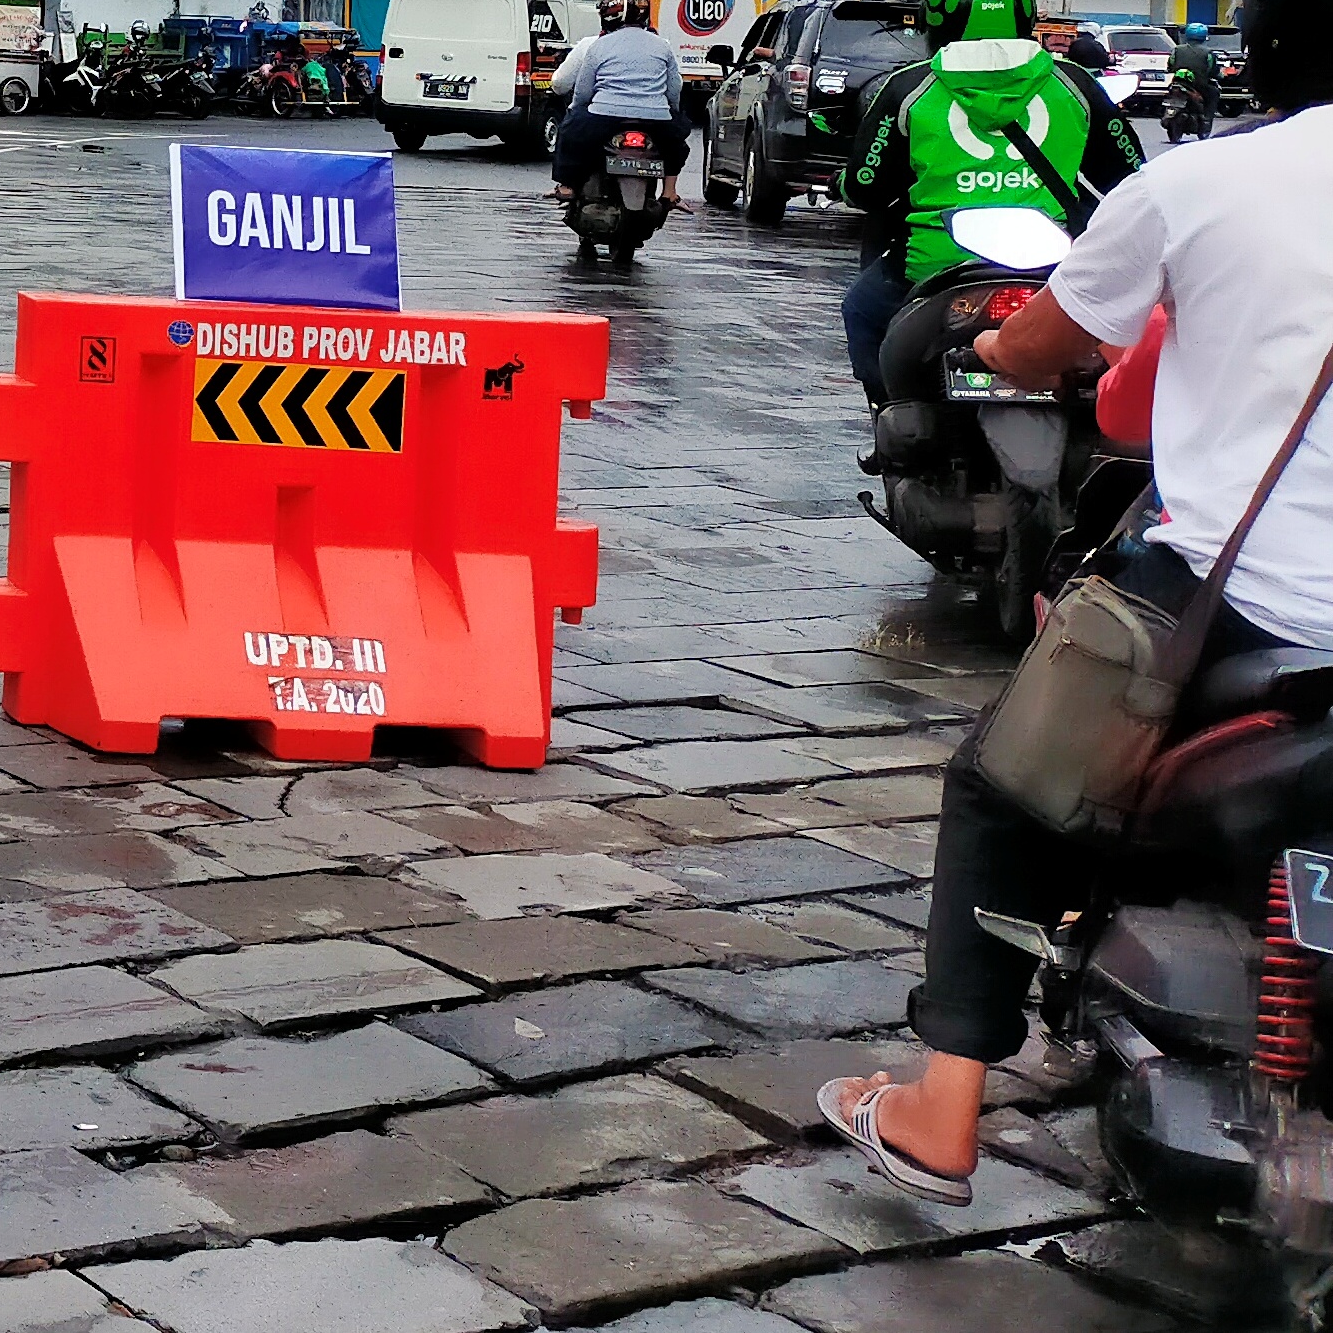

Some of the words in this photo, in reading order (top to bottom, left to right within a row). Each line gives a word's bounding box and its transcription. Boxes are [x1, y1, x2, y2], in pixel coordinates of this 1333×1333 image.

[529, 14, 554, 33] 210
[981, 0, 1005, 11] gojek
[865, 114, 896, 167] gojek
[956, 167, 1040, 193] gojek
[207, 190, 371, 255] GANJIL
[196, 322, 295, 358] DISHUB
[302, 326, 374, 361] PROV
[378, 329, 467, 366] JABAR
[960, 390, 990, 398] YAMAHA
[243, 631, 344, 671] UPTD.
[352, 638, 387, 673] III
[325, 679, 387, 717] 2020
